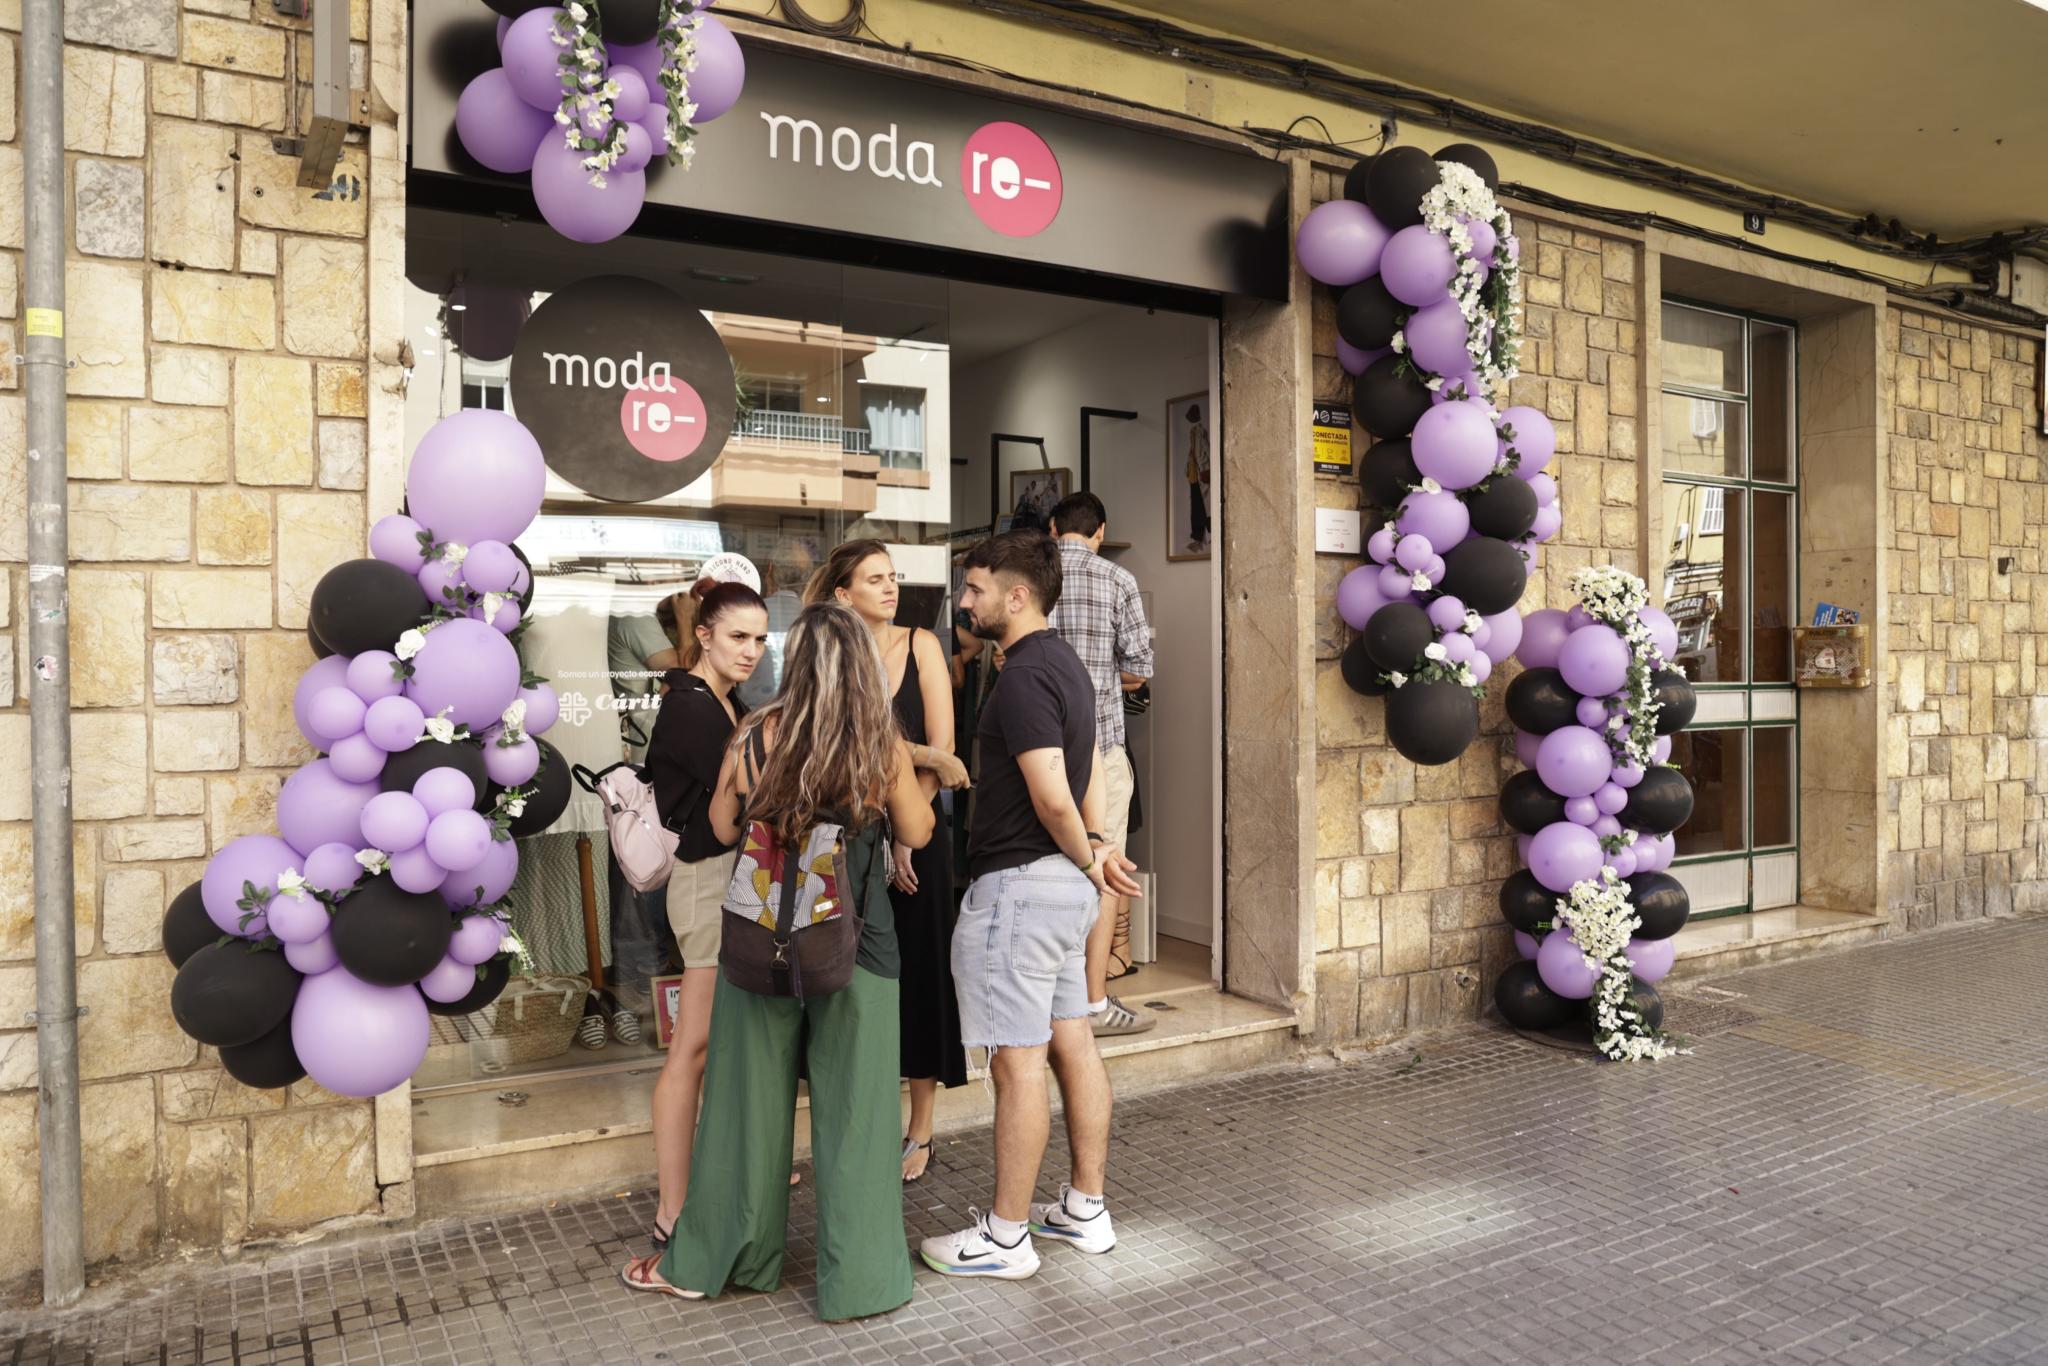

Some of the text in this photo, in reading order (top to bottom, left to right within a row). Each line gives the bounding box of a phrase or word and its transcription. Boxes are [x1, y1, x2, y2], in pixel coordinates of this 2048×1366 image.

[760, 111, 1051, 200] moda re-
[1752, 214, 1760, 230] 9
[542, 351, 677, 394] moda
[632, 400, 696, 433] re-
[736, 560, 751, 574] HAND
[558, 670, 586, 678] Somos
[601, 670, 636, 679] proyecto
[595, 692, 662, 711] Cárit
